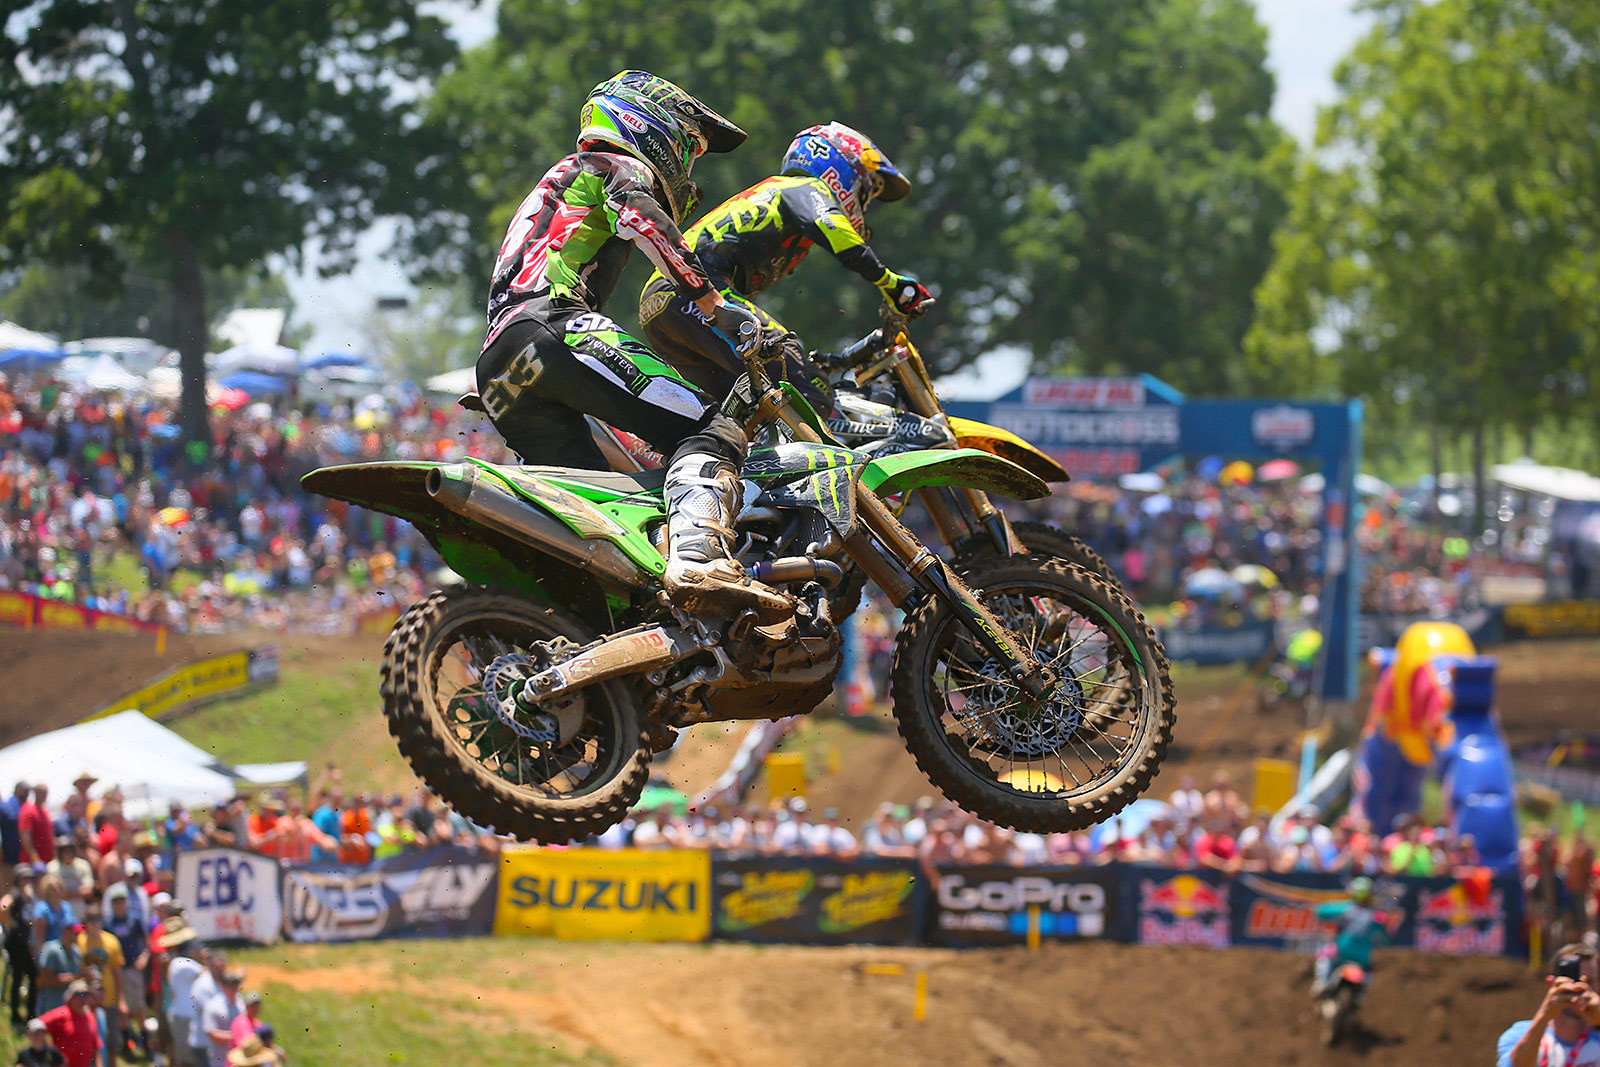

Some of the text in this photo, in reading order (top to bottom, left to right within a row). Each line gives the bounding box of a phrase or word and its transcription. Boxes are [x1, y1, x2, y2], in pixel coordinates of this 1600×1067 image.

[622, 113, 643, 131] BELL
[821, 167, 854, 203] Red
[583, 334, 635, 375] MONSTER
[196, 857, 255, 912] EBC
[509, 875, 698, 912] SUZUKI
[937, 874, 1106, 914] GoPro
